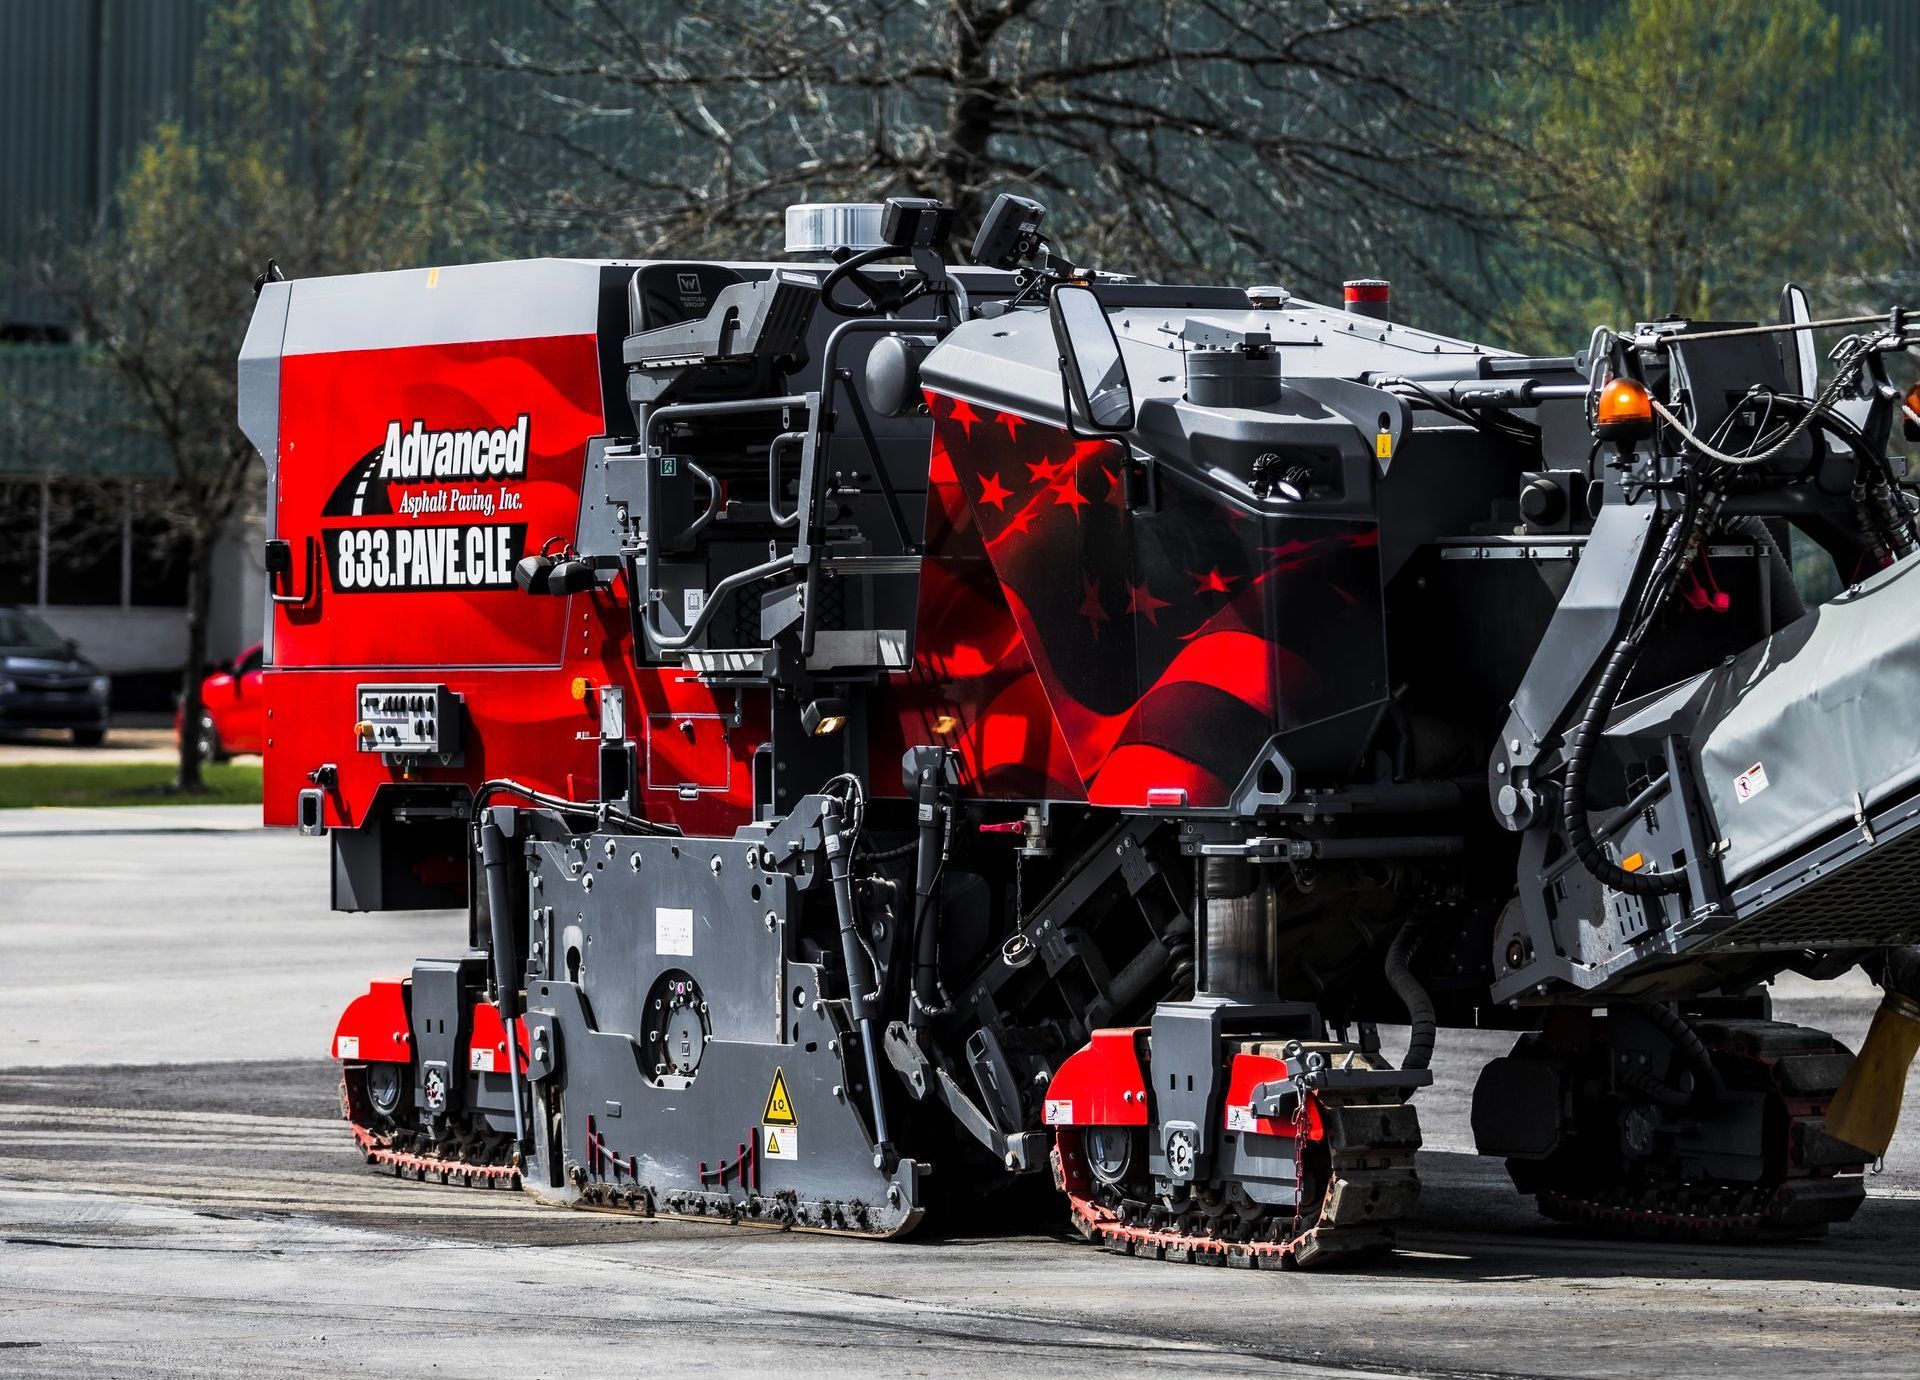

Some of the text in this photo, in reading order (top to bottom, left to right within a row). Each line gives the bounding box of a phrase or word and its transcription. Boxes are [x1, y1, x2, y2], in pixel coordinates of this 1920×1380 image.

[379, 416, 528, 479] Advanced
[399, 487, 522, 518] Asphalt Paving, Inc.
[338, 526, 512, 588] 833.PAVE.CLE
